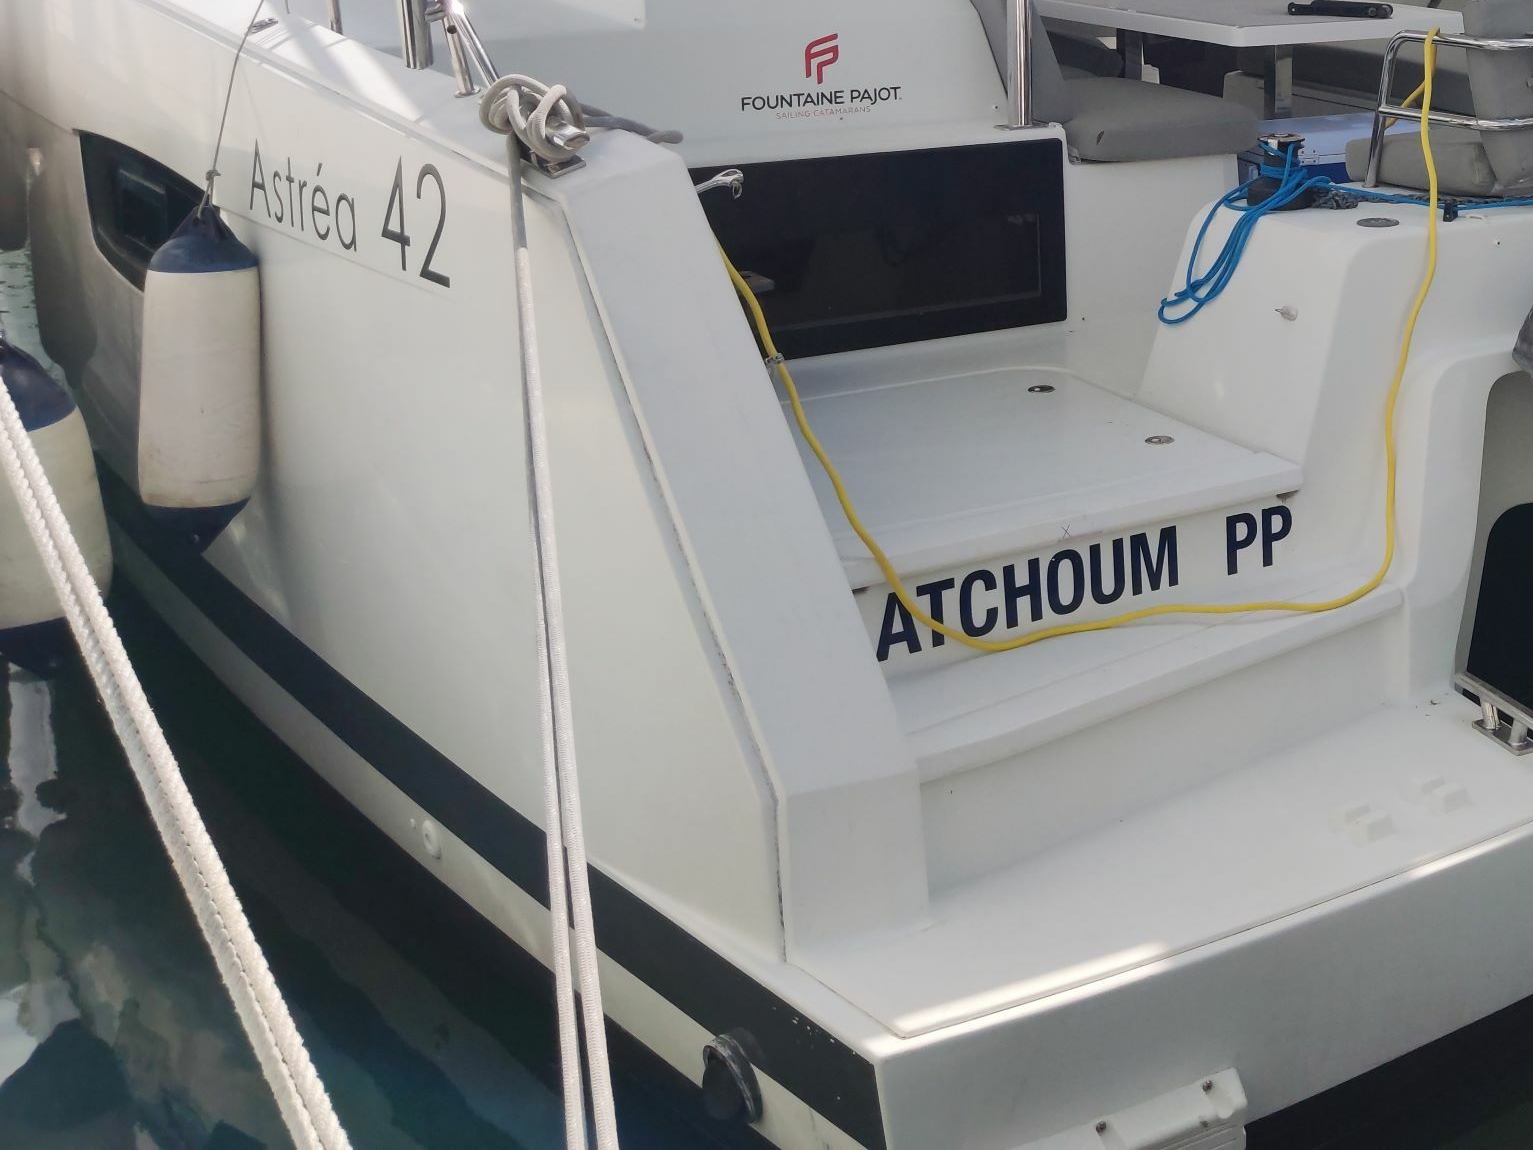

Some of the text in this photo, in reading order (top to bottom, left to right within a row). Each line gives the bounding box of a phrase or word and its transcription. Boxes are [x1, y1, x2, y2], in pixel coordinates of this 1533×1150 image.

[741, 86, 902, 112] FOUNTAINE PAJOT
[775, 105, 871, 121] SAILING CATAMARANS
[249, 137, 451, 289] Astréa 42
[876, 505, 1293, 662] ATCHOUM PP
